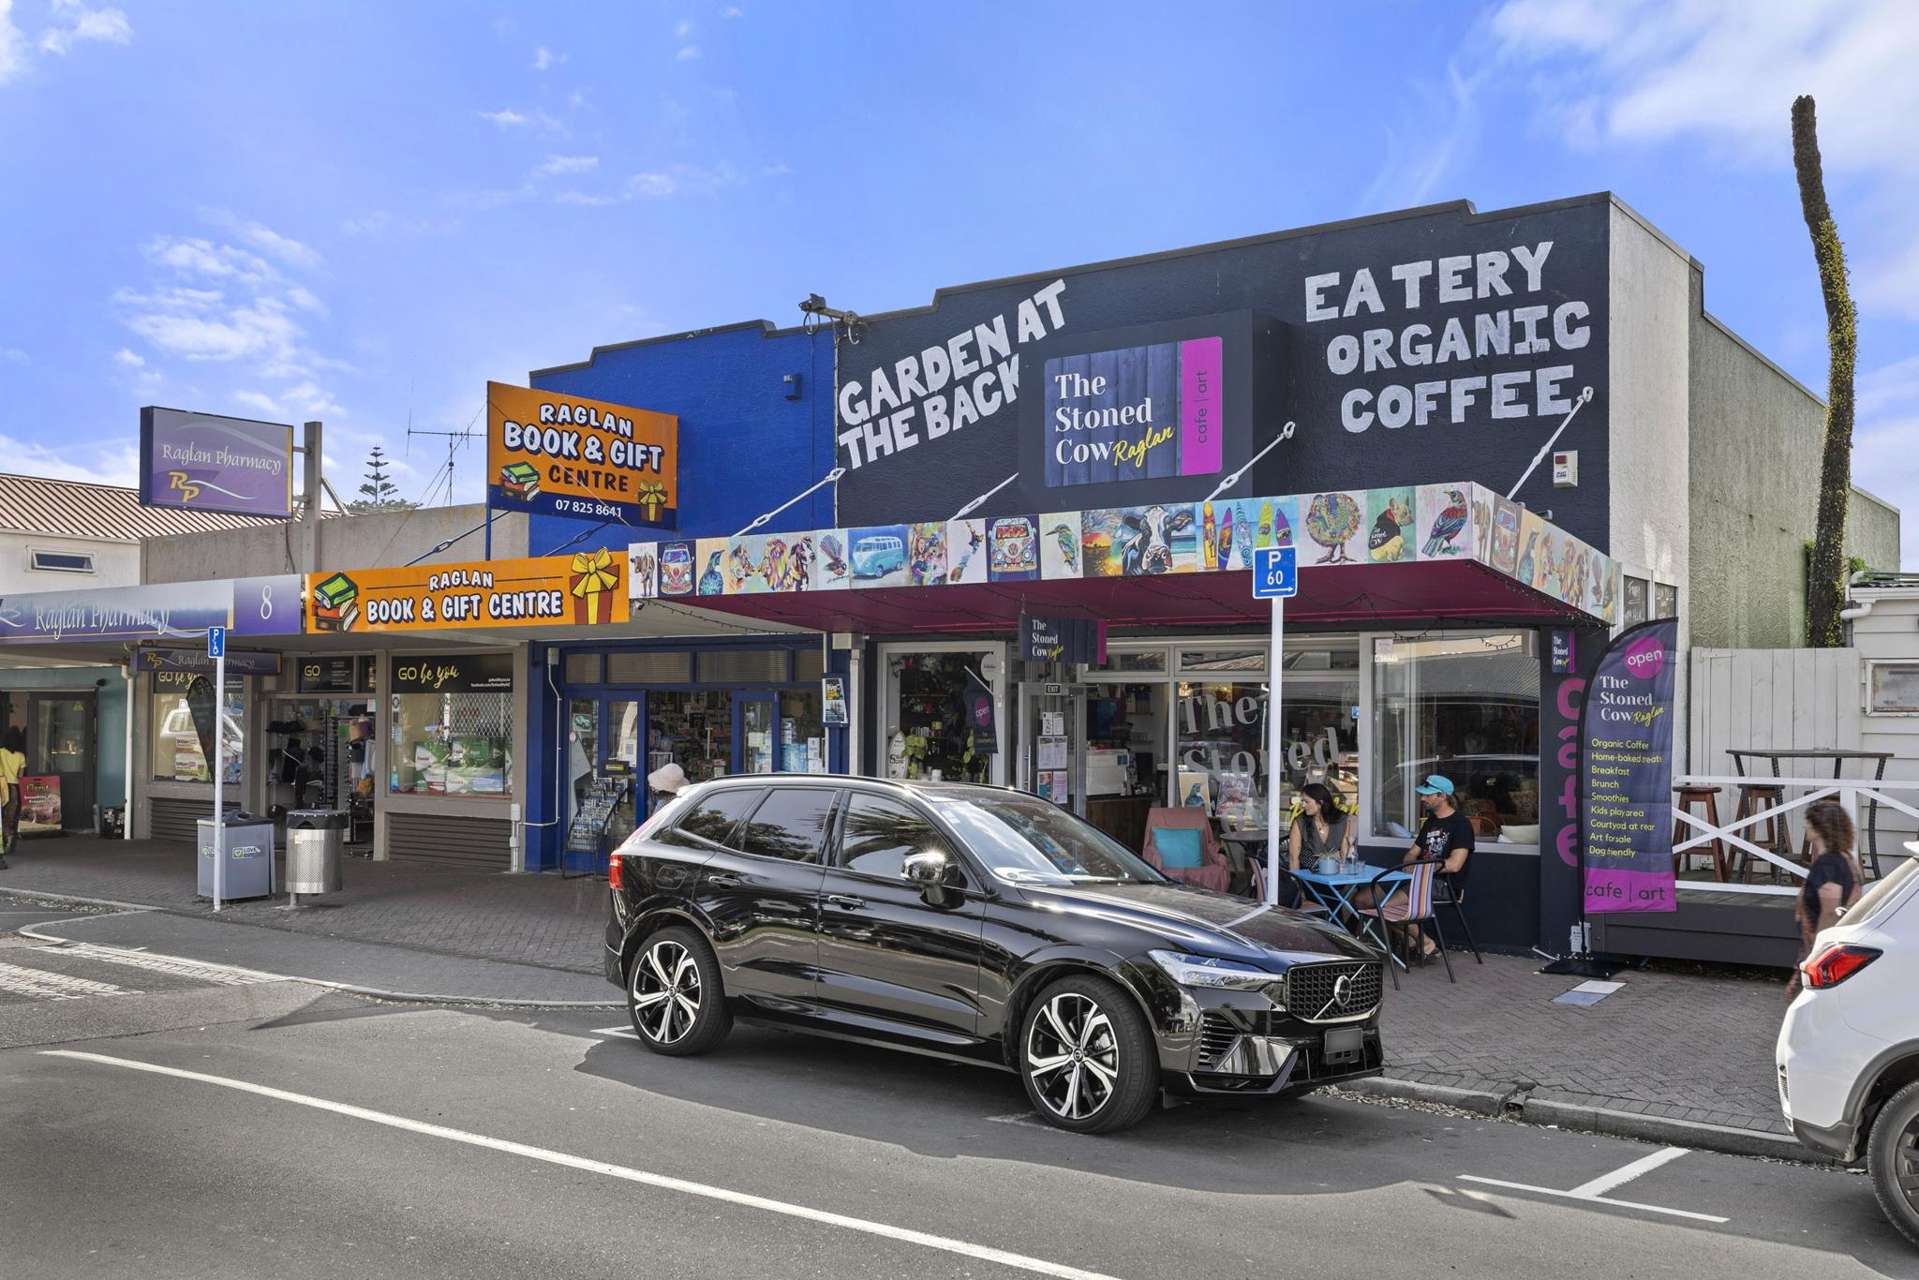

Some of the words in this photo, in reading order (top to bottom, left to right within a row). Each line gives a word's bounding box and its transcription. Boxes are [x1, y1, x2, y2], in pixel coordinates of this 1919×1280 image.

[1304, 241, 1554, 323] EATERY
[1326, 301, 1591, 375] ORGANIC
[838, 314, 1011, 425] GARDEN
[1018, 279, 1066, 343] AT
[1055, 373, 1106, 399] The
[1196, 370, 1208, 394] art
[1340, 364, 1574, 433] COFFEE
[540, 403, 633, 438] RAGLAN
[838, 406, 919, 470] THE
[923, 353, 1019, 440] BACK
[1055, 397, 1152, 432] Stoned
[1194, 407, 1208, 444] cafe
[503, 421, 581, 461] BOOK
[584, 434, 605, 465] &
[610, 438, 664, 473] GIFT
[1055, 439, 1113, 464] Cow
[1113, 425, 1175, 468] Raglan
[161, 441, 211, 466] Raglan
[215, 445, 281, 475] Pharmacy
[549, 464, 630, 492] CENTRE
[555, 499, 571, 511] 07
[572, 500, 594, 514] 825
[595, 503, 622, 518] 8641
[1269, 551, 1281, 570] P
[428, 570, 494, 592] RAGLAN
[1267, 570, 1283, 585] 60
[260, 584, 272, 620] 8
[366, 596, 415, 625] BOOK
[421, 597, 435, 621] &
[441, 595, 483, 621] GIFT
[488, 591, 564, 619] CENTRE
[34, 605, 86, 640] Raglan
[91, 604, 170, 635] Pharmacy
[1031, 619, 1047, 630] The
[1031, 632, 1058, 644] Stoned
[1627, 649, 1662, 668] open
[159, 672, 173, 682] GO
[304, 665, 320, 677] GO
[398, 667, 417, 680] GO
[420, 663, 434, 684] be
[433, 665, 460, 689] you
[1600, 675, 1629, 689] The
[1600, 691, 1653, 706] Stoned
[1178, 691, 1259, 734] The
[1600, 708, 1633, 721] Cow
[1632, 705, 1664, 727] Raglan
[1591, 738, 1624, 749] Organic
[1591, 752, 1641, 763] Home-baked
[1591, 765, 1630, 776] Breakfast
[1591, 779, 1619, 789] Brunch
[1591, 792, 1629, 803] Smoothies
[1591, 806, 1608, 815] Kids
[1610, 808, 1625, 818] play
[1590, 832, 1603, 841] Art
[1605, 833, 1616, 841] for
[1616, 834, 1632, 843] sale
[1589, 845, 1606, 856] Dog
[1586, 881, 1622, 898] cafe
[1638, 887, 1665, 901] art
